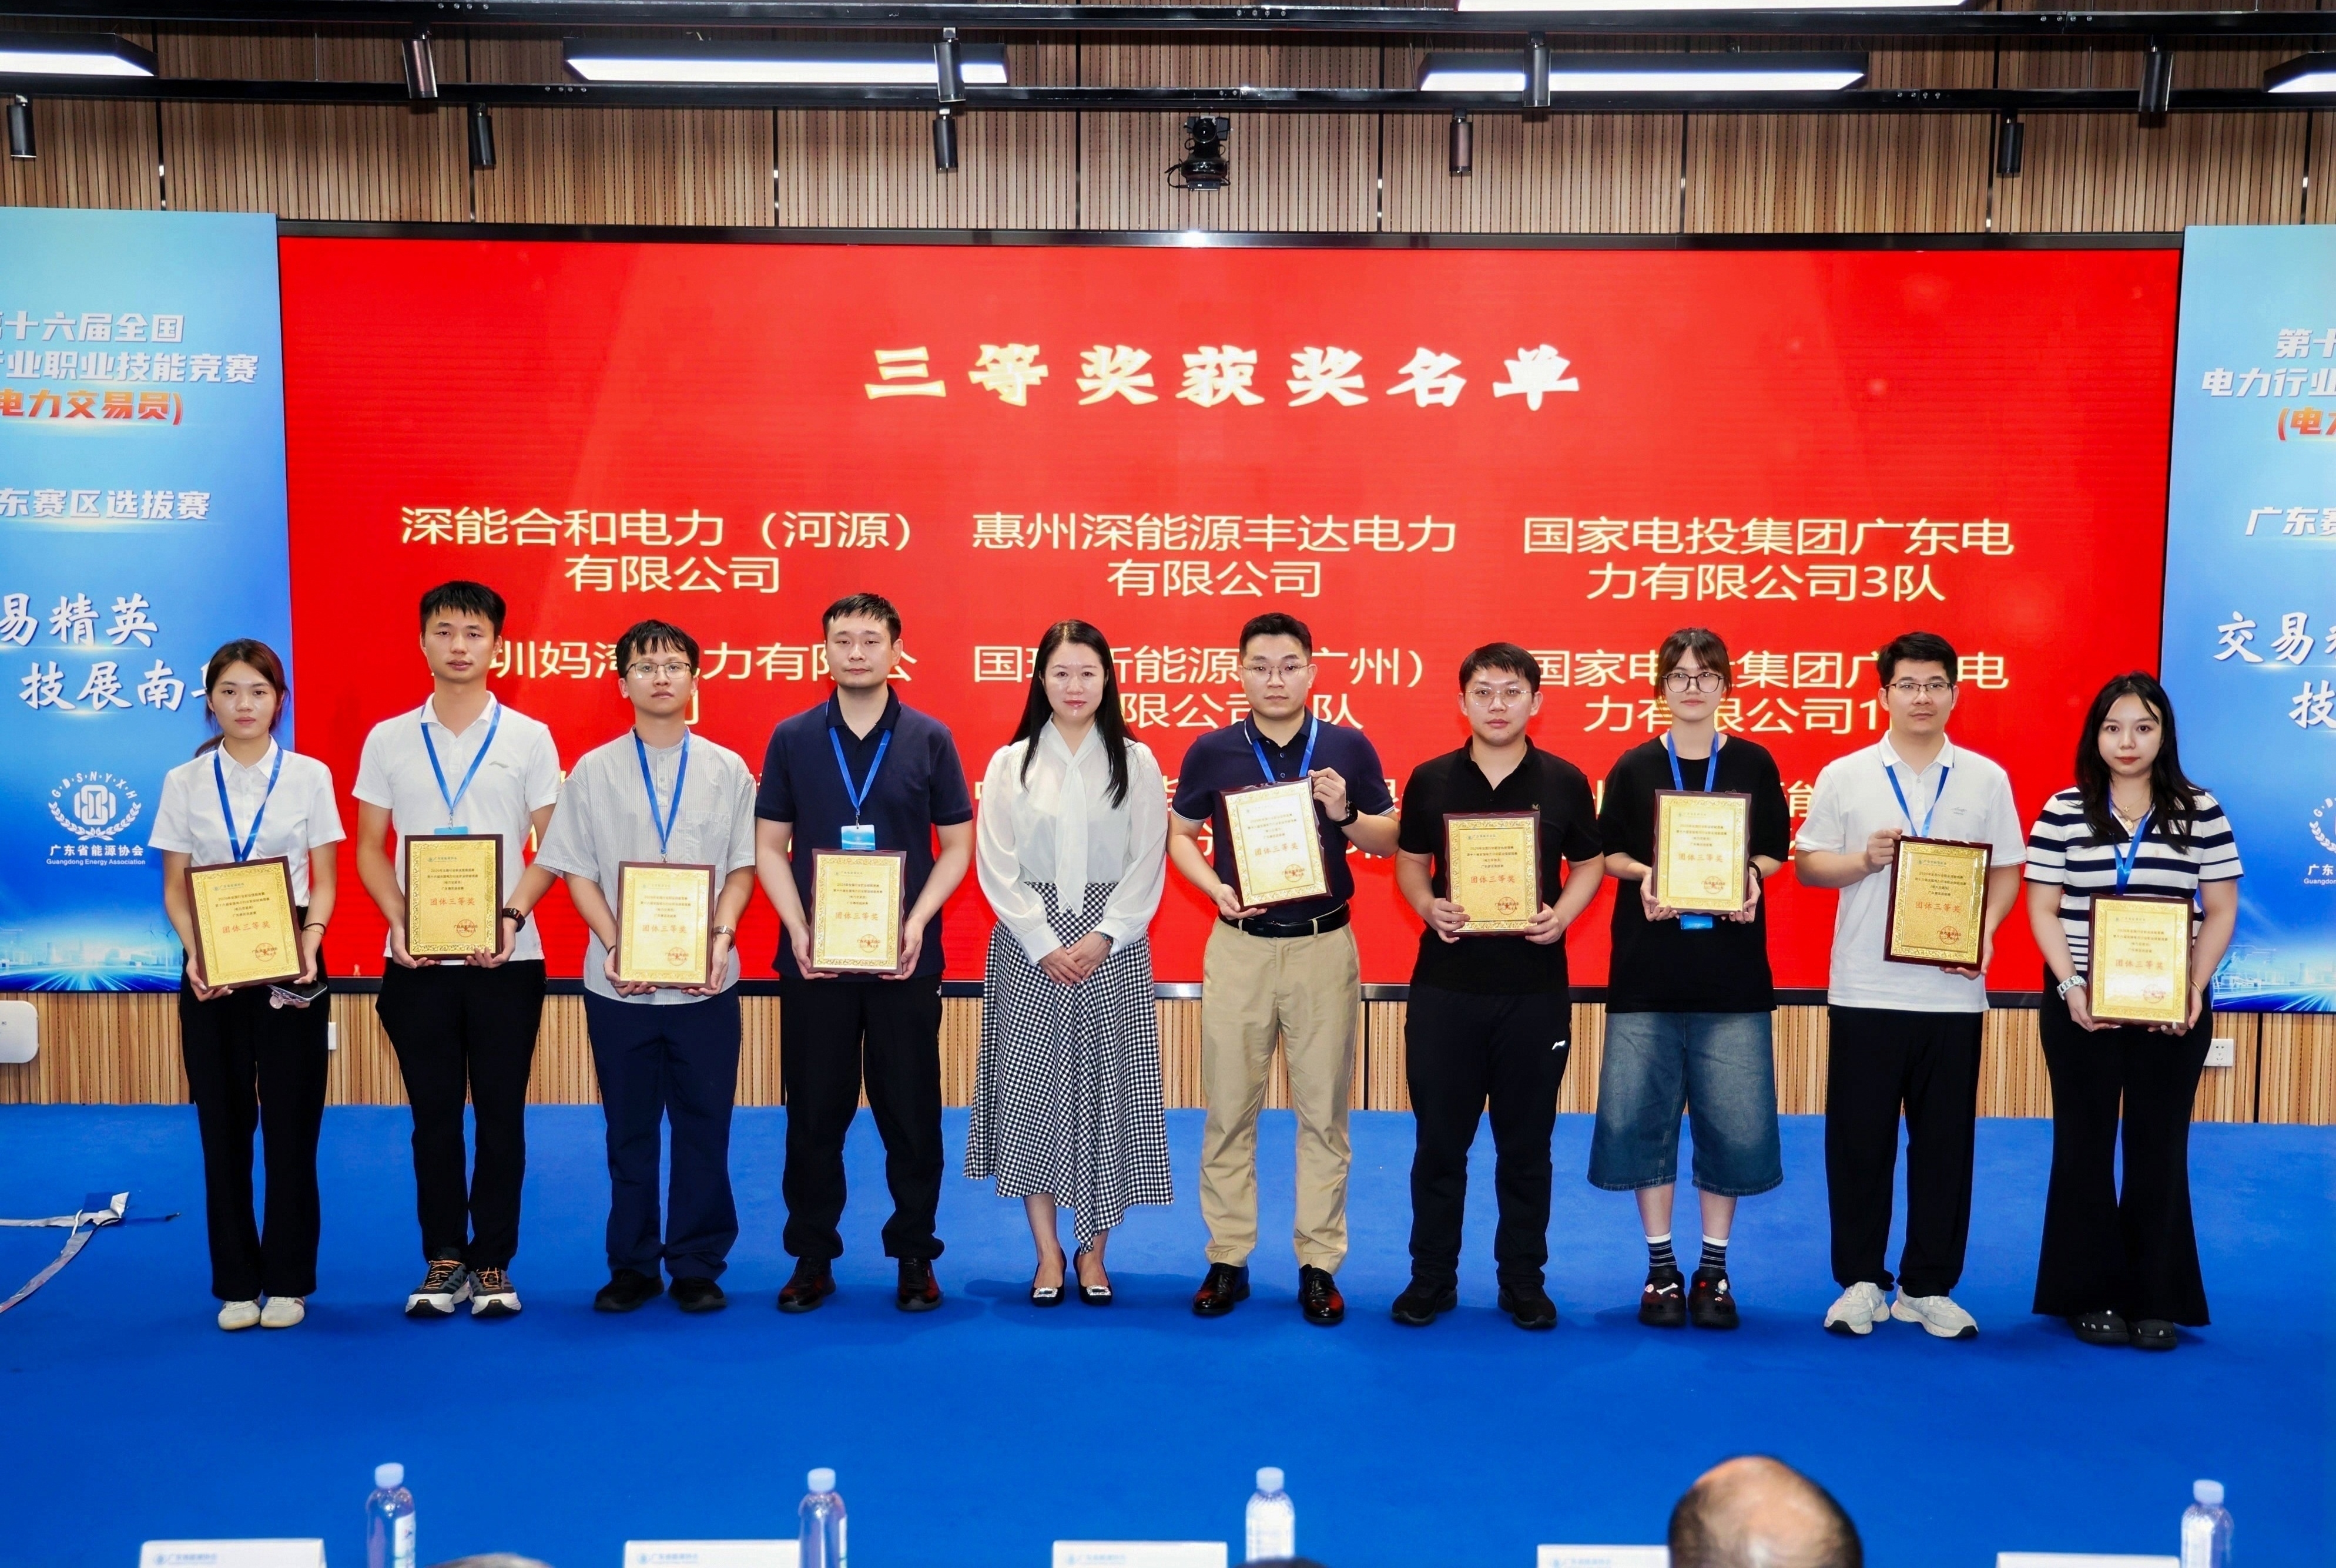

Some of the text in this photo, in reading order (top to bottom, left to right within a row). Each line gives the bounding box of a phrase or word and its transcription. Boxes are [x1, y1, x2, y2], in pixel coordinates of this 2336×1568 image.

[0, 311, 185, 343] 十六届全国
[0, 350, 259, 383] 业职业技能竞赛
[864, 343, 1579, 411] 三等奖获奖名单
[0, 488, 210, 520] 东赛区选拔赛
[401, 506, 910, 550] 深能合和电力（河源）
[972, 511, 1456, 553] 惠州深能源丰达电力
[1523, 516, 2014, 557] 国家电投集团广东电
[564, 554, 780, 594] 有限公司
[1107, 559, 1321, 597] 有限公司
[1586, 563, 1945, 603] 力有限公司3队
[0, 593, 159, 647] 易精英
[2213, 610, 2336, 665] 交易
[19, 659, 207, 711] 技展南
[1583, 695, 1892, 735] 力有限公司1
[49, 844, 143, 856] 广东省能源协会
[2307, 864, 2336, 876] 广东
